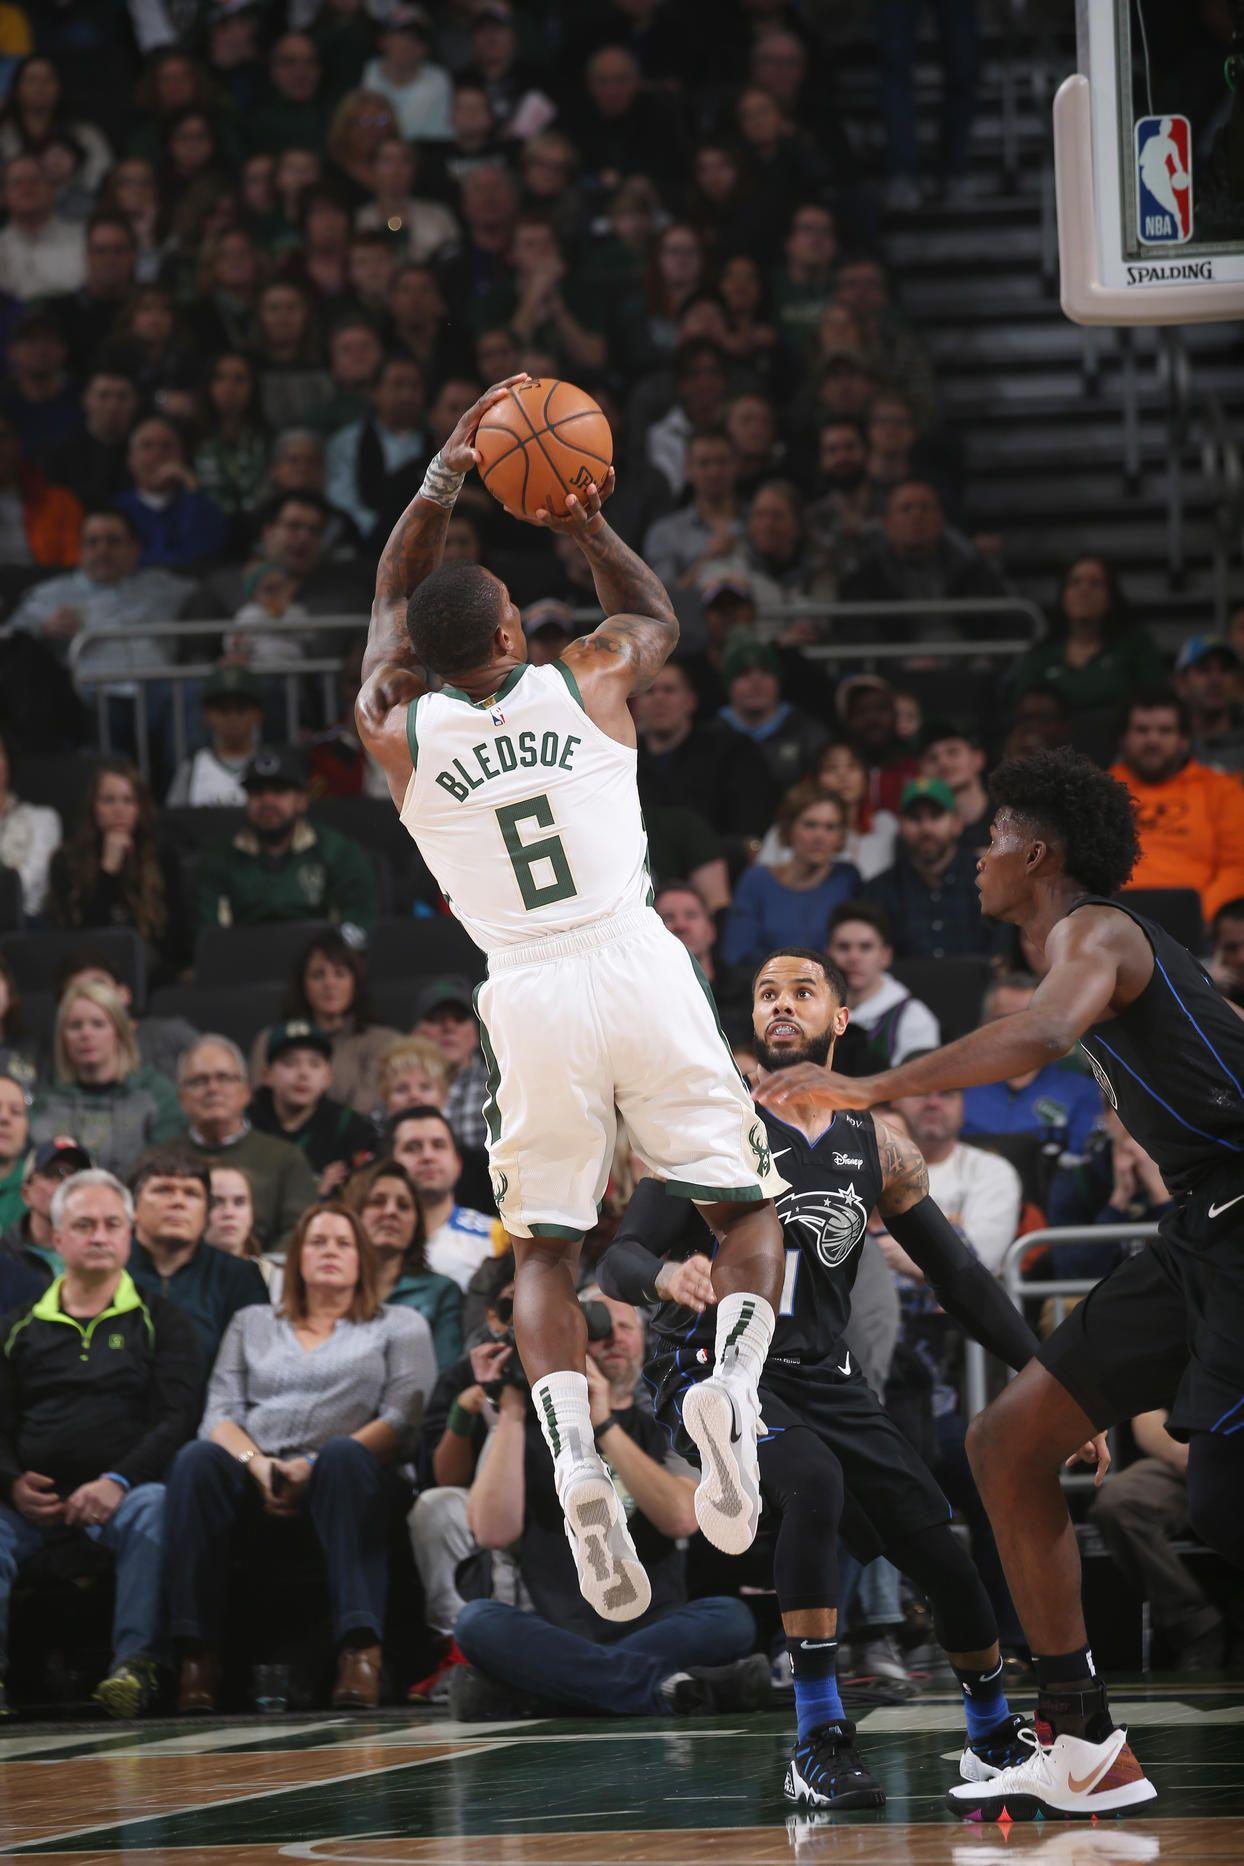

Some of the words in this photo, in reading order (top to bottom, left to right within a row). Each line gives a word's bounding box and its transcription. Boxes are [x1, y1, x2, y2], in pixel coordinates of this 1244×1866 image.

[1145, 215, 1173, 237] NBA
[1127, 261, 1213, 285] SPALDING
[435, 731, 582, 803] BLEDSOE
[493, 792, 579, 912] 6
[832, 1151, 864, 1170] Disney
